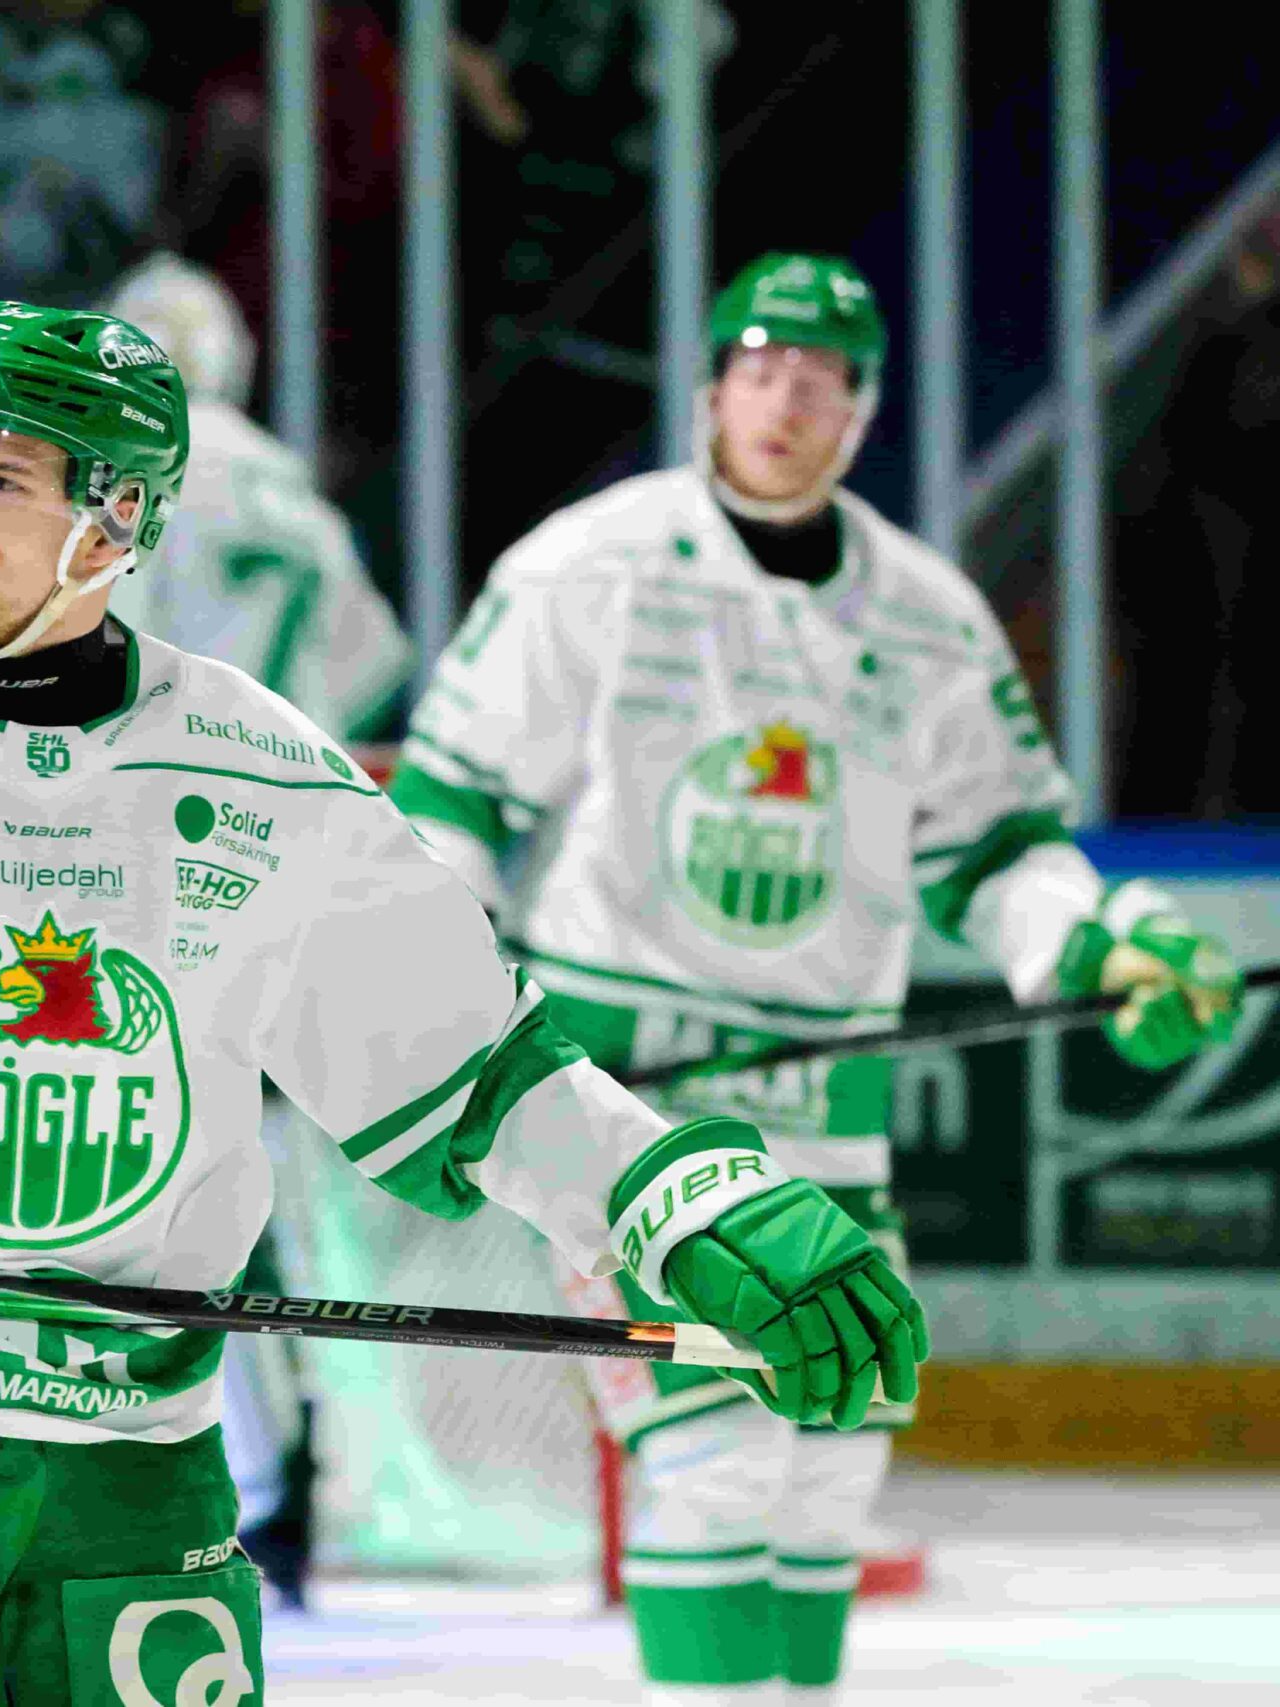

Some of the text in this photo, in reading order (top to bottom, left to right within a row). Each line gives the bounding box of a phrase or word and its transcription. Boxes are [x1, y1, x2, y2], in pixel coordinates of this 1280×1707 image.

[26, 732, 69, 747] SHL
[184, 713, 316, 766] Backahill
[26, 746, 71, 774] 50
[218, 803, 273, 842] Solid
[0, 860, 124, 892] liljedahl
[78, 888, 125, 899] group
[241, 1295, 435, 1325] BAUER
